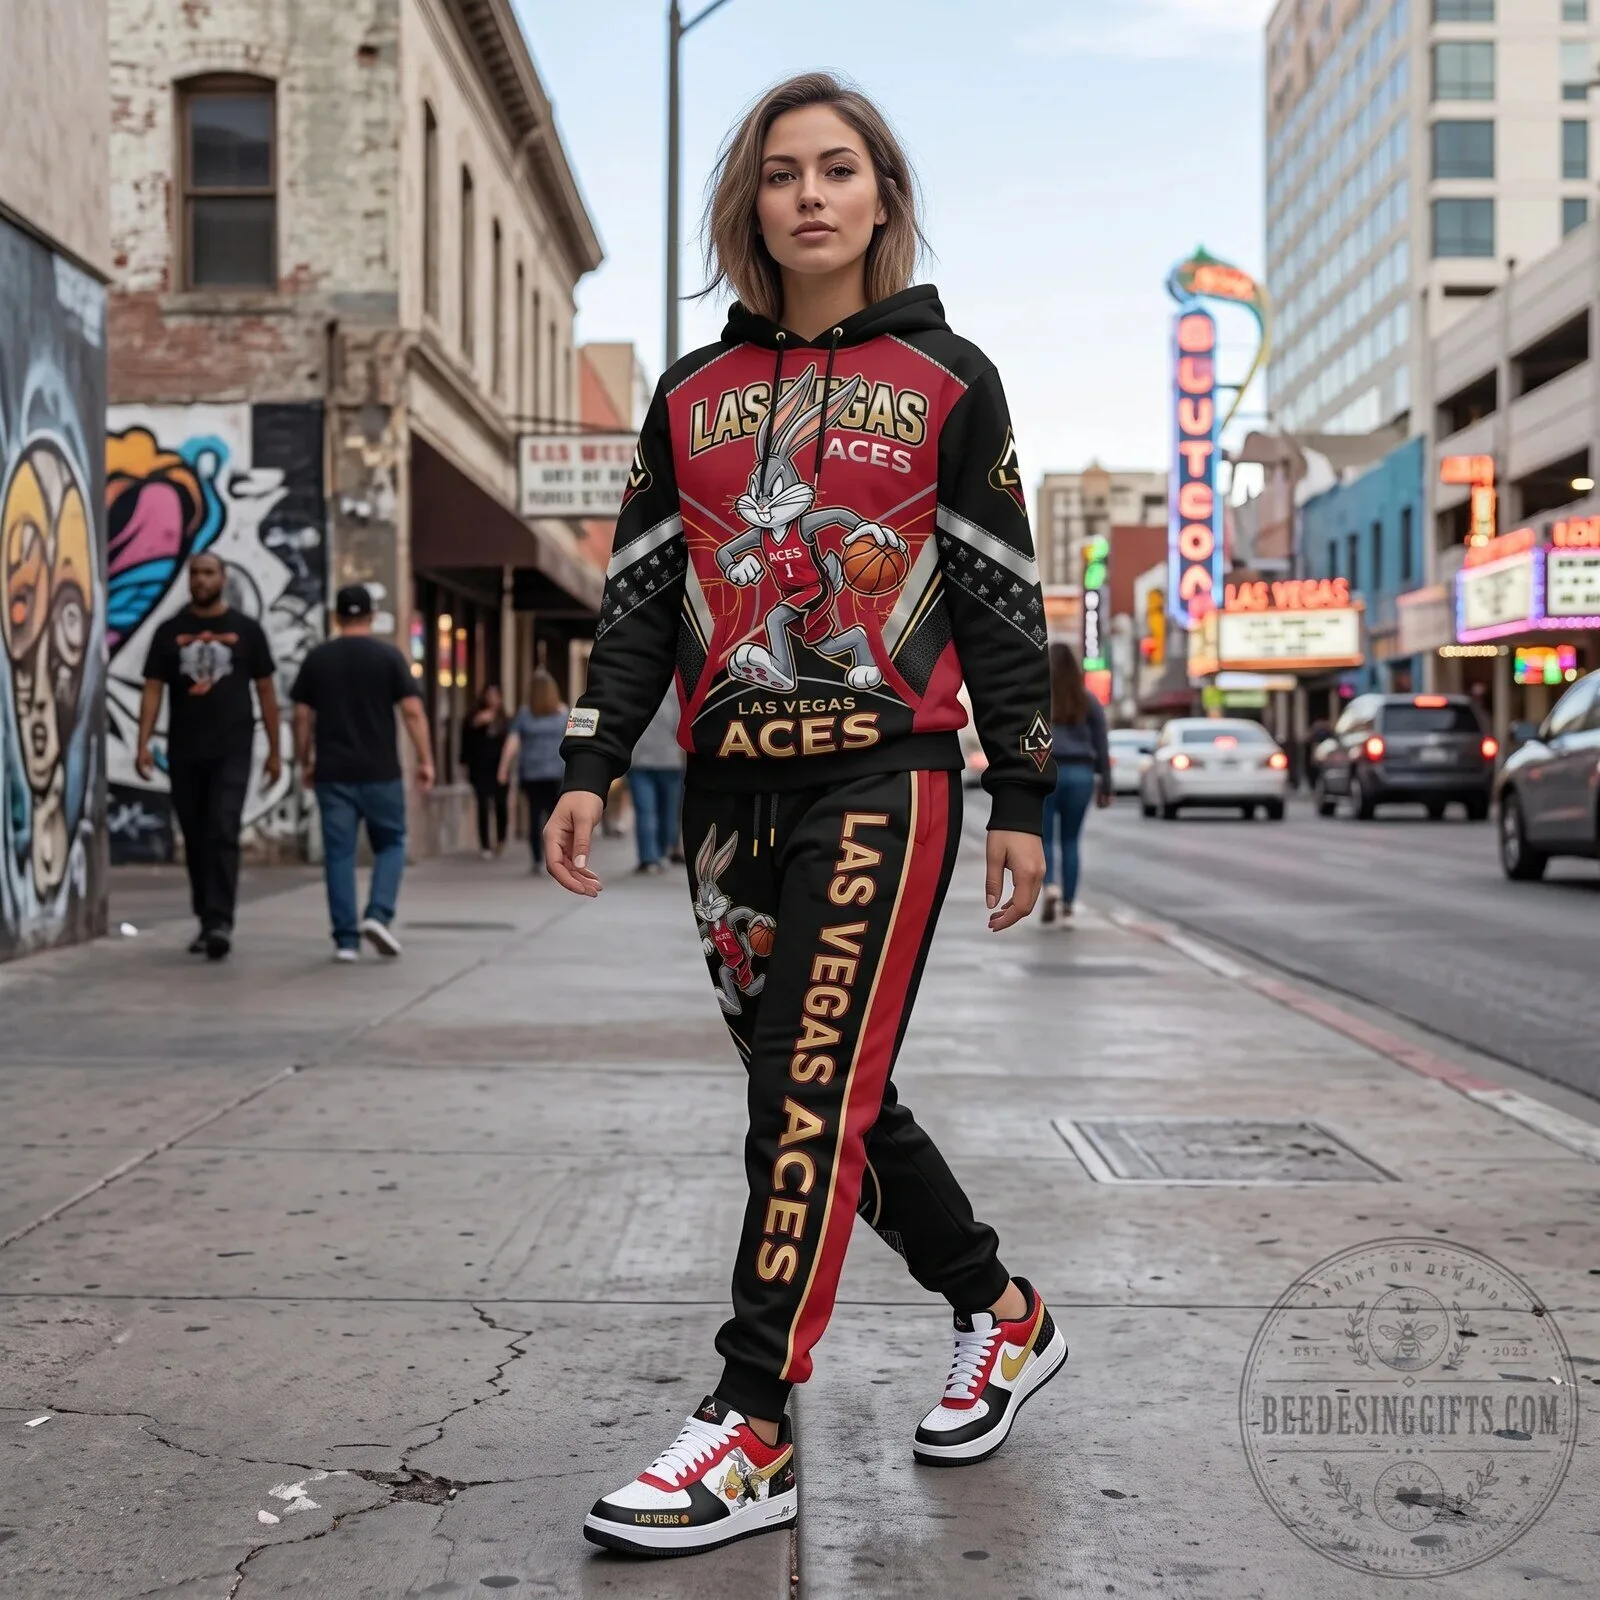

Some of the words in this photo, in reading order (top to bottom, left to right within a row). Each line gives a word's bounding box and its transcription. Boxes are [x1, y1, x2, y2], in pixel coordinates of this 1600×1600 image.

[689, 383, 770, 459] LAS
[823, 437, 912, 474] ACES
[769, 547, 802, 562] ACES
[785, 563, 794, 578] 1
[1224, 581, 1269, 611] LAS
[738, 700, 778, 715] LAS
[783, 697, 856, 714] VEGAS
[716, 712, 881, 758] ACES
[827, 811, 890, 906] LAS
[790, 920, 869, 1085] VEGAS
[755, 1095, 826, 1285] ACES
[634, 1513, 651, 1524] LAS
[653, 1514, 680, 1525] VEGAS
